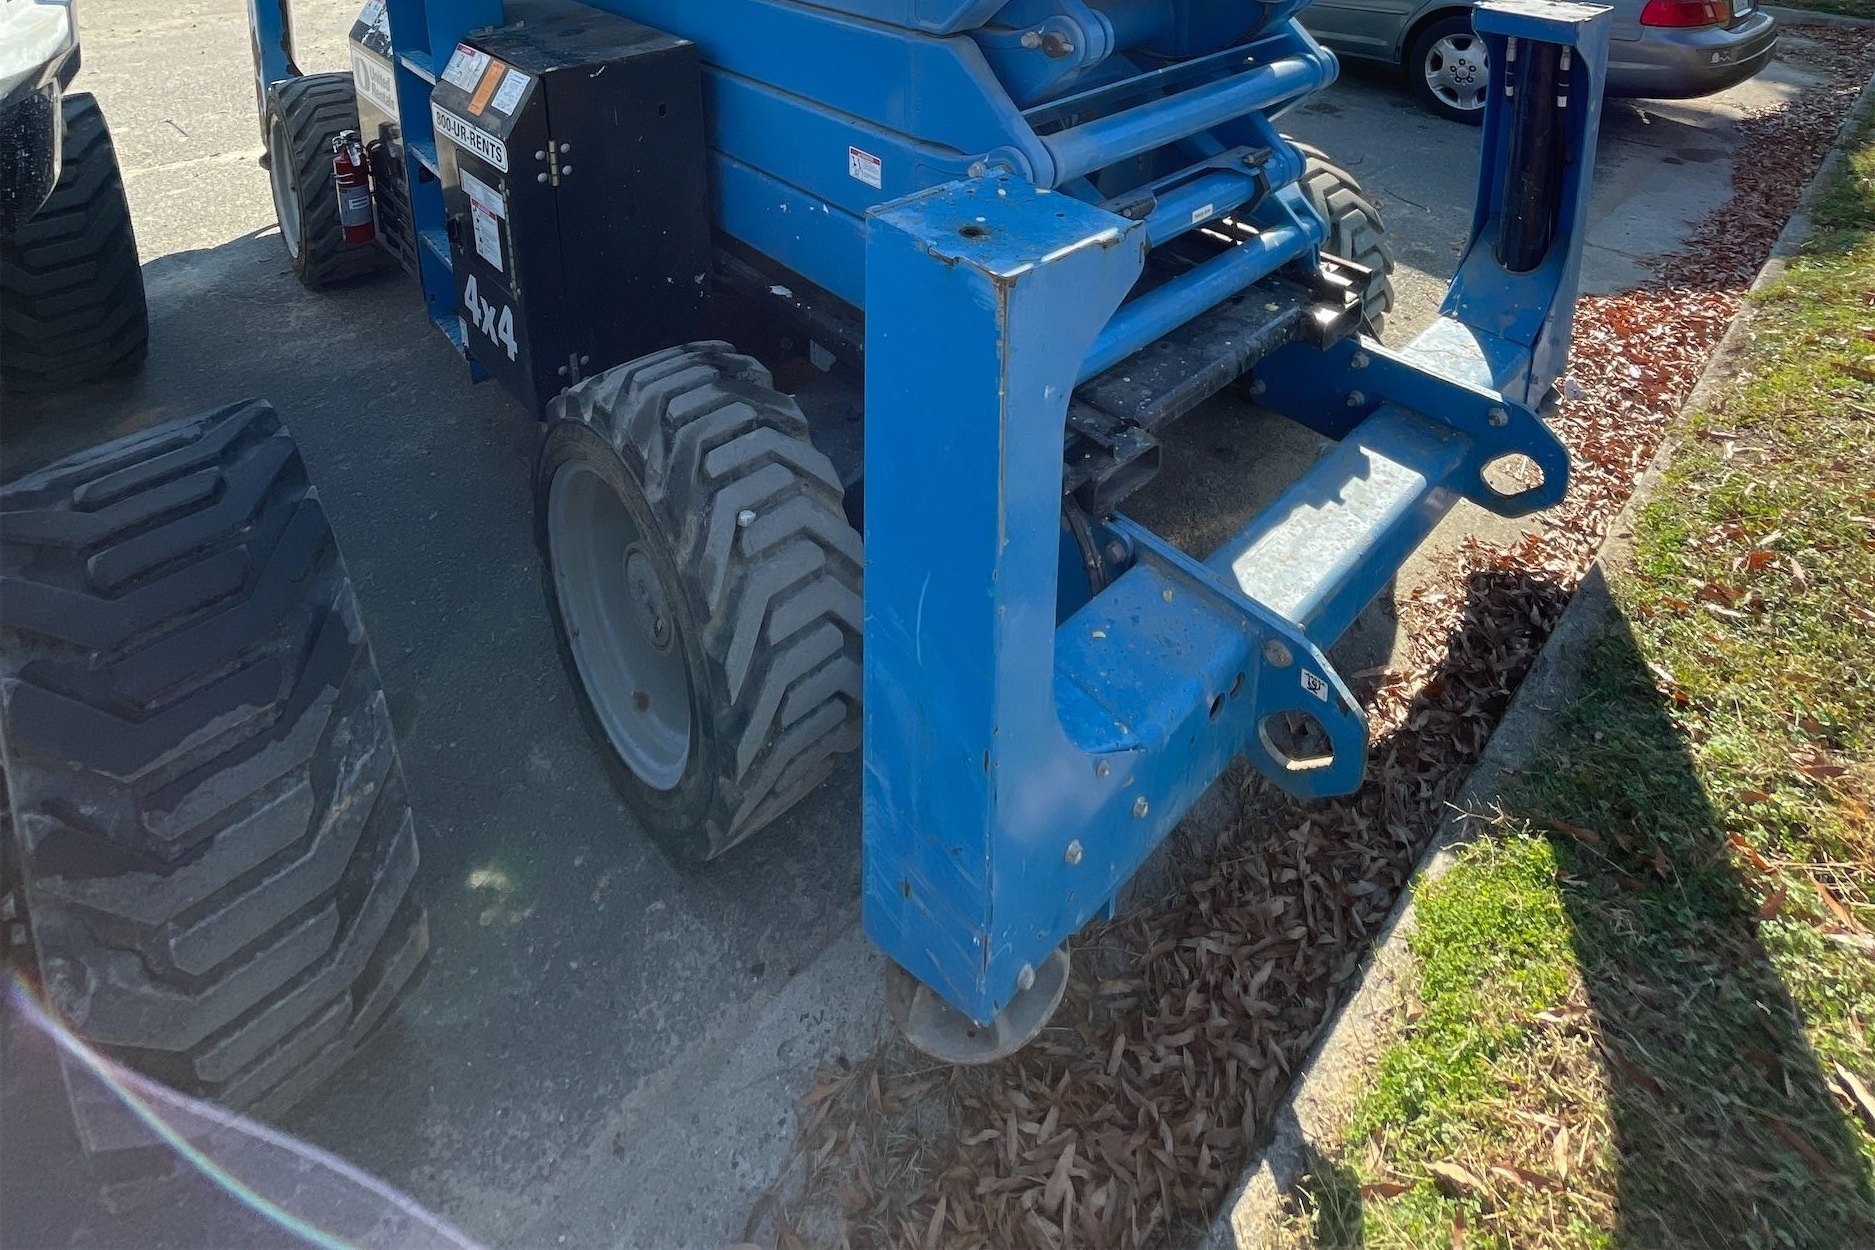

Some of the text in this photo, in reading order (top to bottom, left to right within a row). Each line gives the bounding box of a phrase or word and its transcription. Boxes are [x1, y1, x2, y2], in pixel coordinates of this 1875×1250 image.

[369, 64, 391, 92] United
[371, 82, 395, 111] Rentals
[436, 111, 503, 163] 800-UR-RENTS
[464, 273, 518, 362] 4x4
